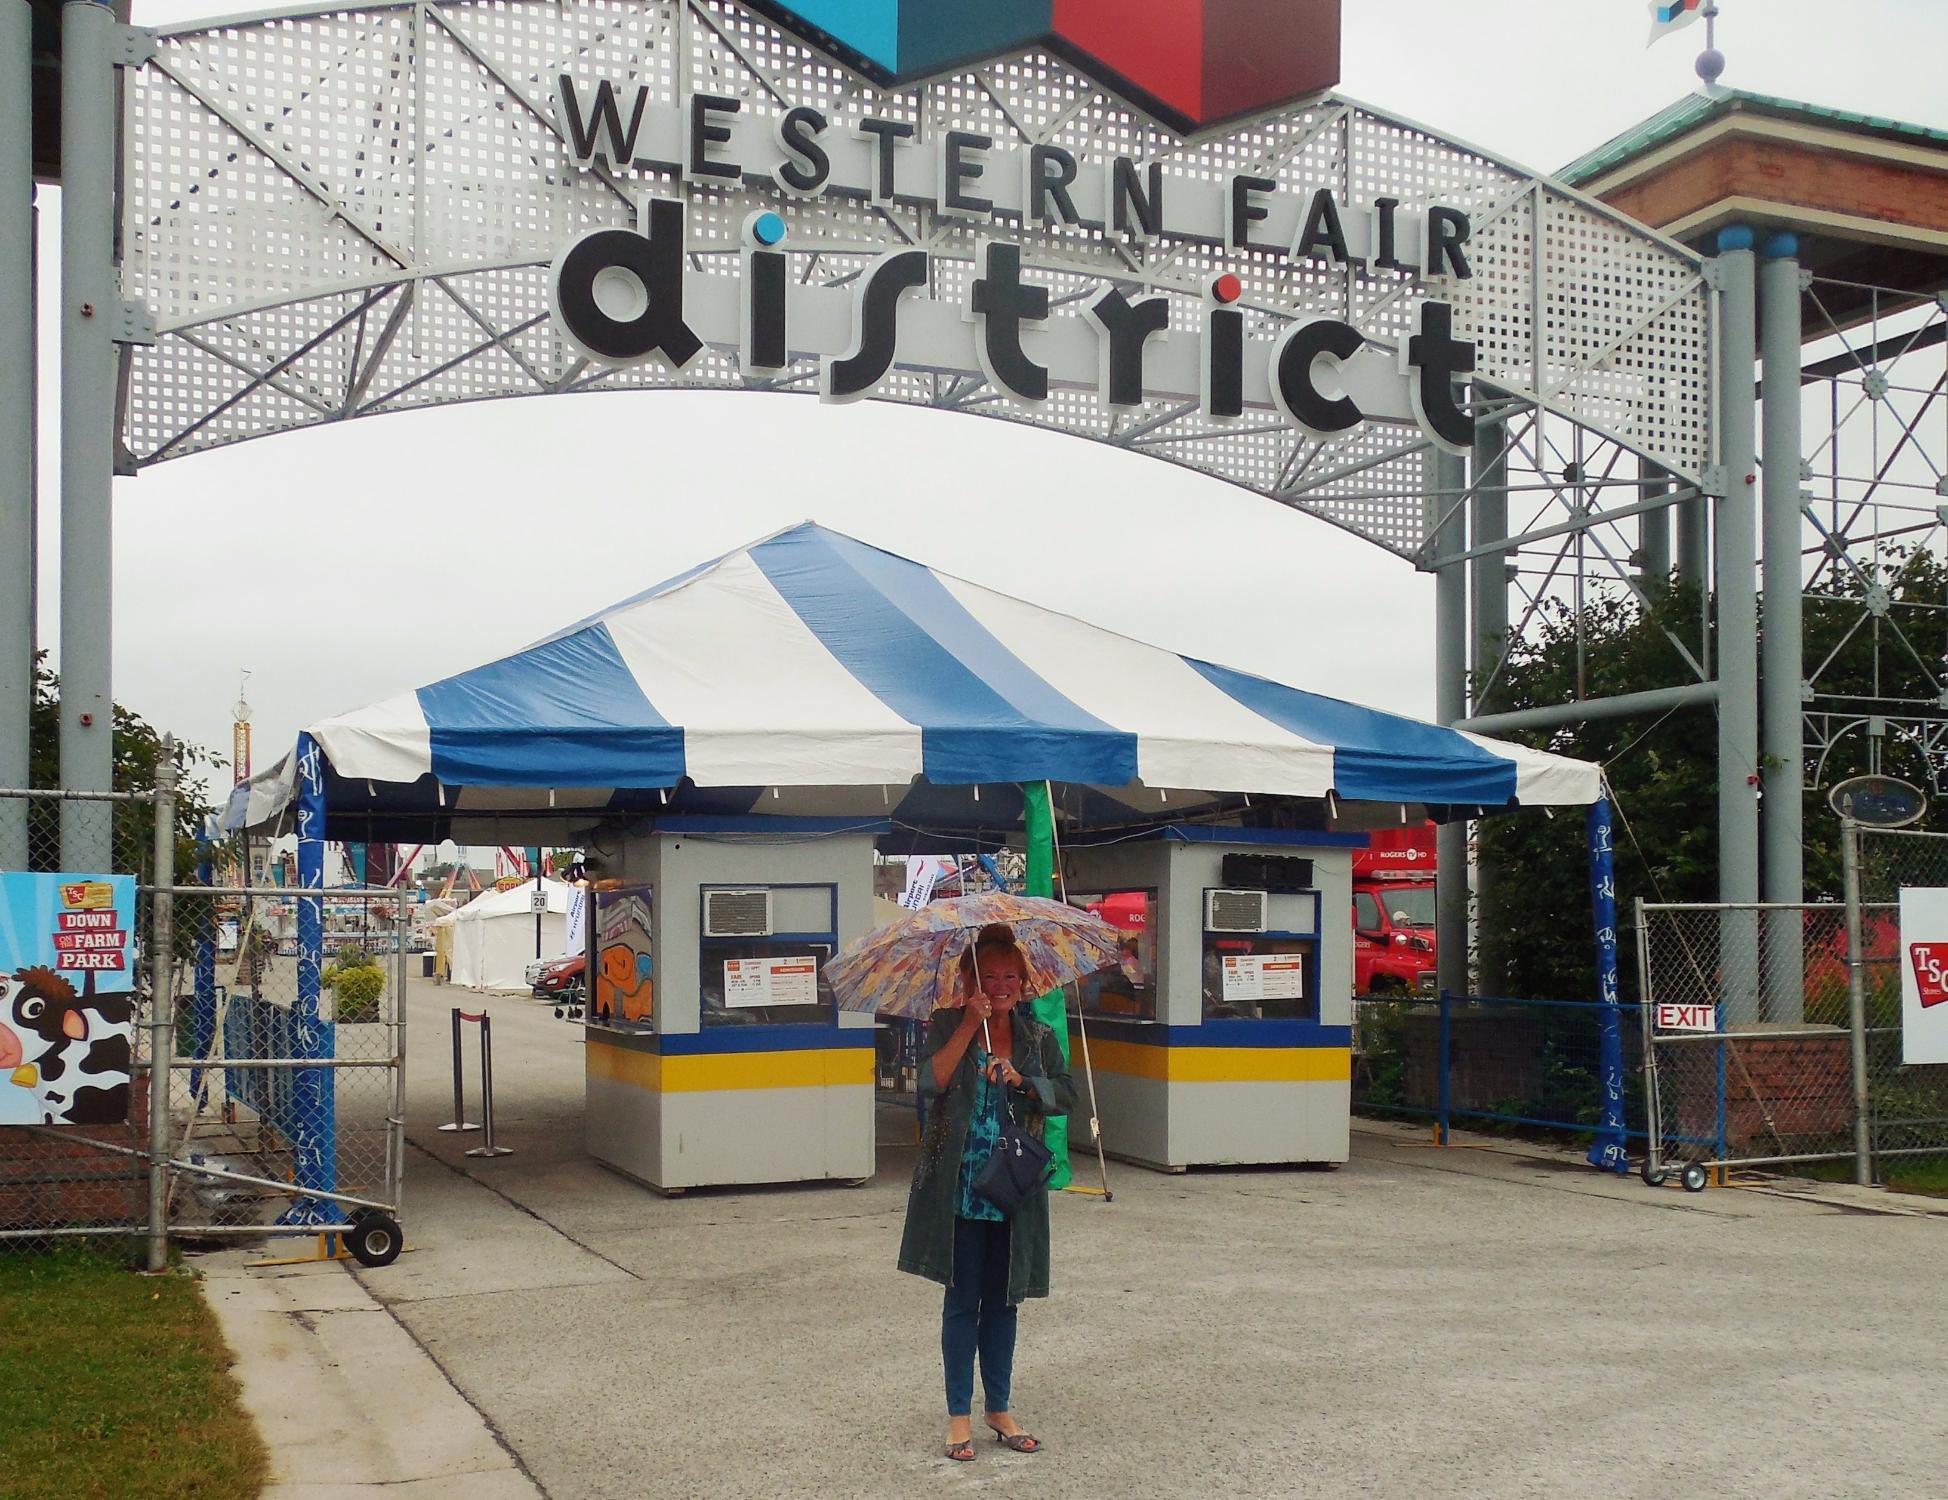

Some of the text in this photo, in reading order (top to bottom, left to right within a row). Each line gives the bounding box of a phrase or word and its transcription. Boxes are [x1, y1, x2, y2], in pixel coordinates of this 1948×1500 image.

[558, 73, 1472, 281] WESTERN FAIR
[556, 198, 1476, 448] district
[66, 887, 83, 900] TSC
[533, 897, 545, 907] 20
[570, 890, 582, 918] Airport
[66, 914, 112, 928] DOWN
[59, 935, 72, 943] ON
[74, 933, 120, 948] FARM
[61, 953, 117, 968] PARK
[1914, 947, 1948, 993] TSC
[1660, 1006, 1713, 1026] EXIT
